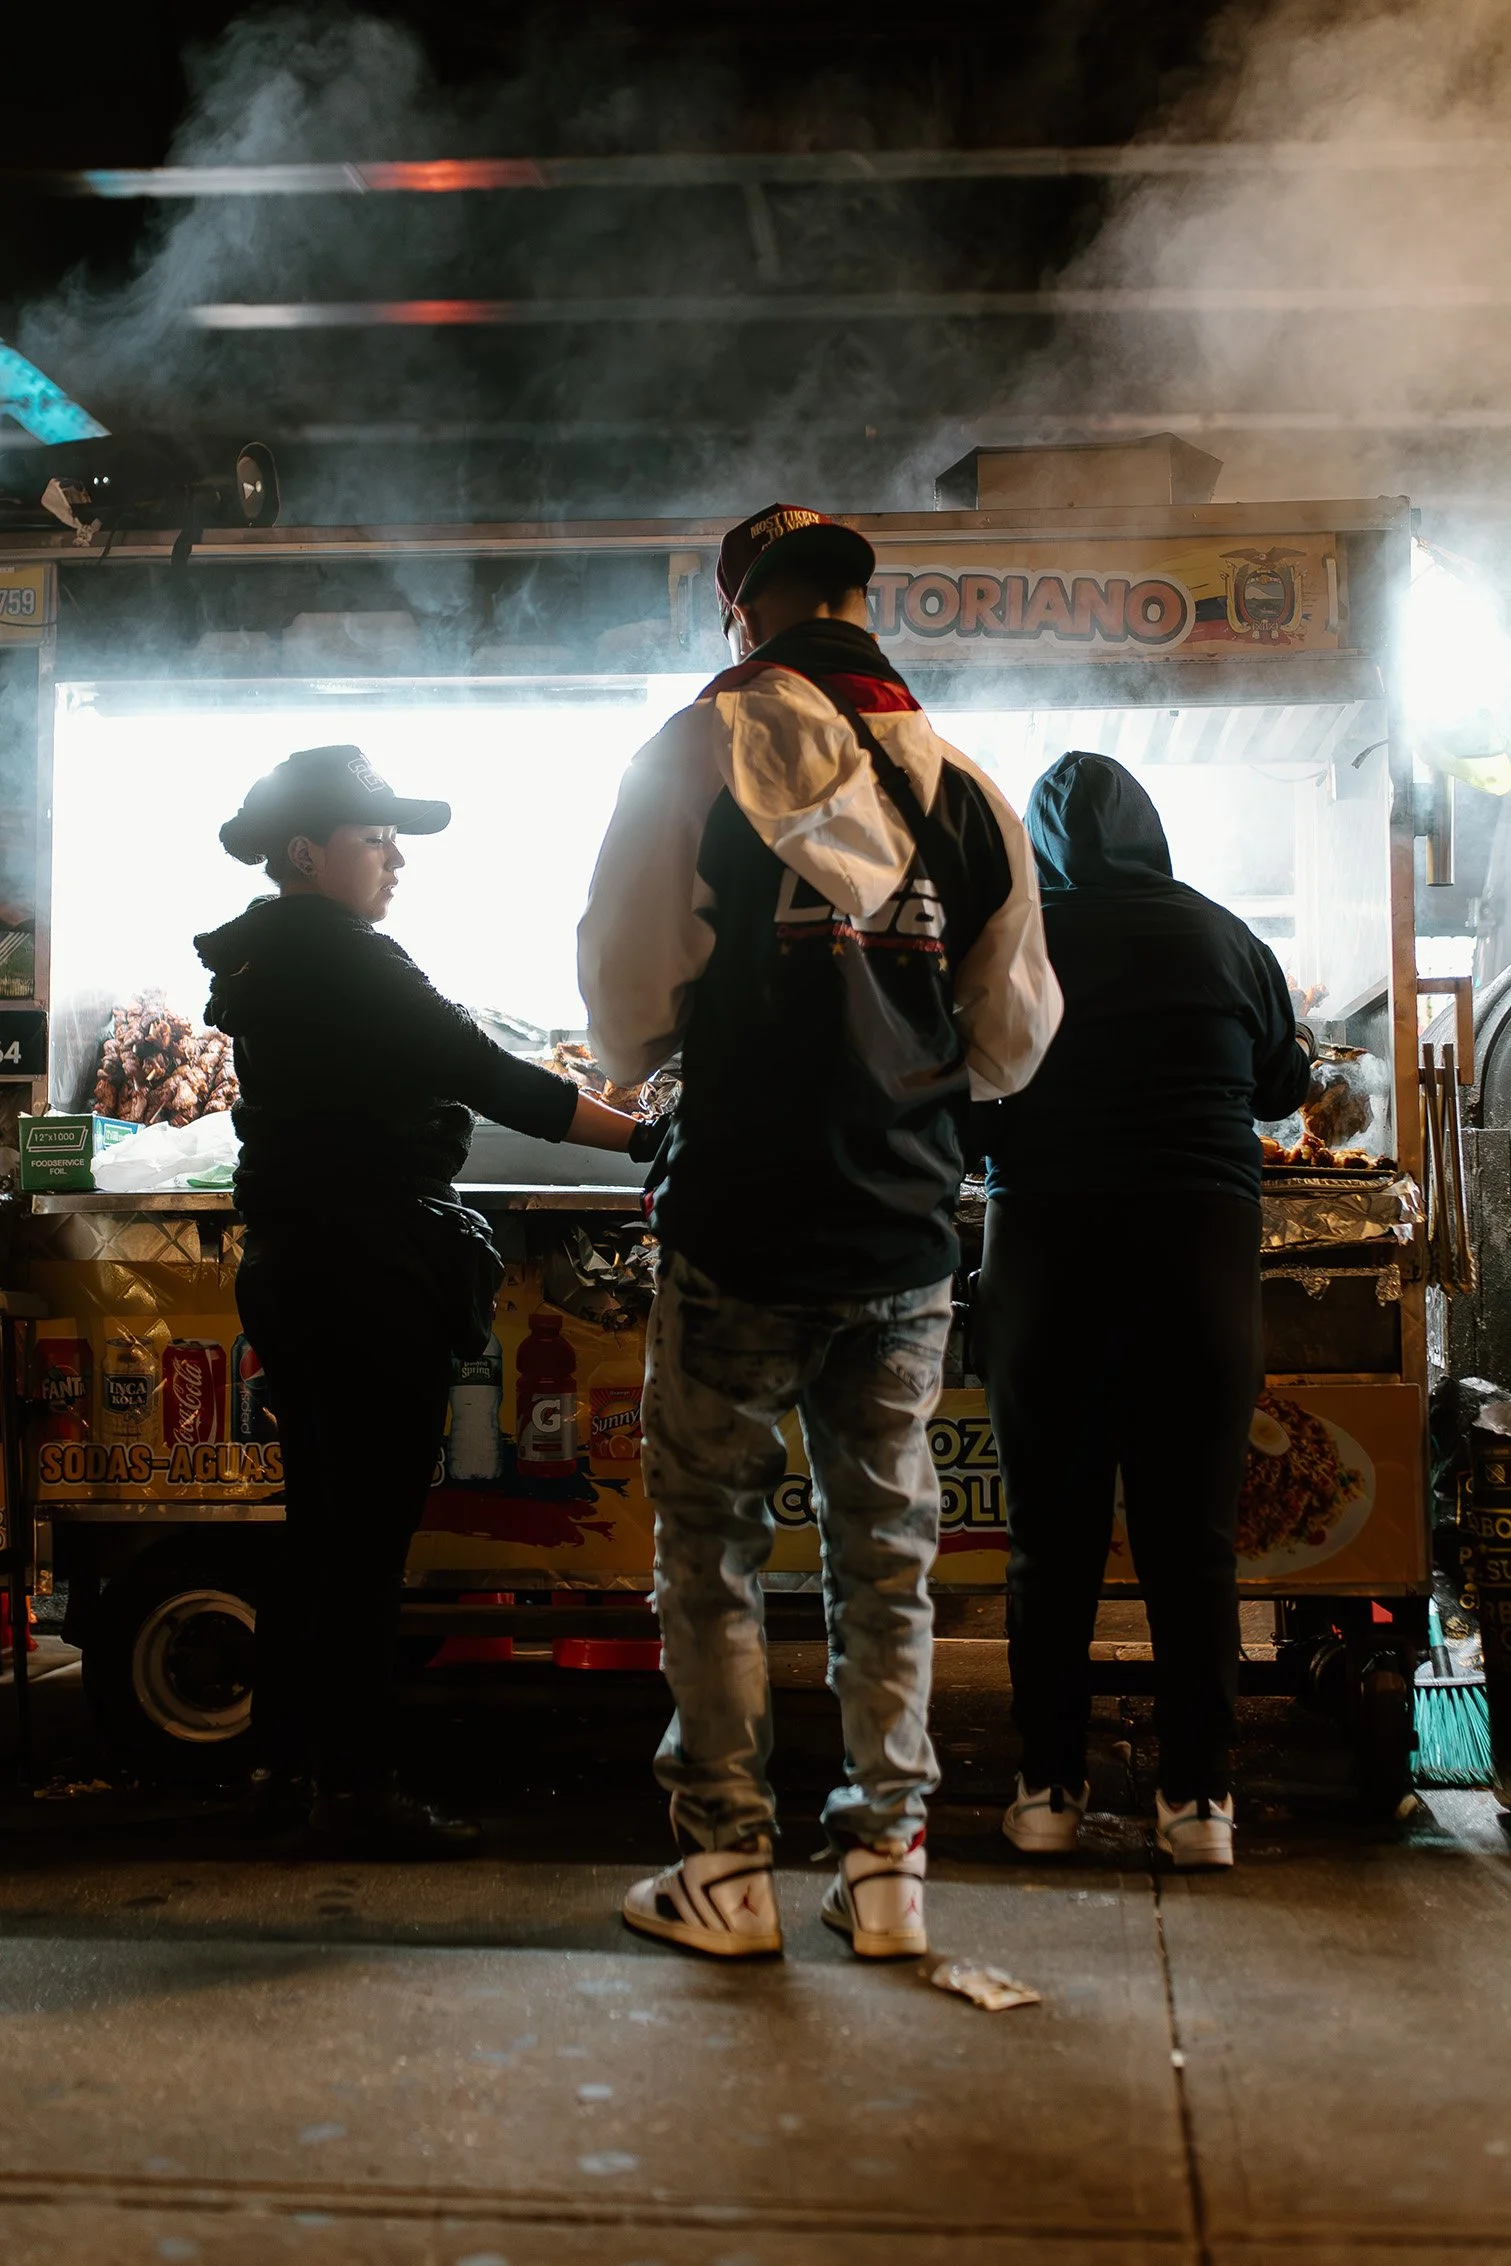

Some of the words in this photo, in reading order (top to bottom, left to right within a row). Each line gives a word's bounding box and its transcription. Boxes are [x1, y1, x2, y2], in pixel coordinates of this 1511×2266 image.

[751, 512, 781, 539] MOST
[0, 588, 37, 616] 759
[866, 572, 1187, 644] TORIANO
[0, 1040, 21, 1064] 4
[31, 1158, 85, 1168] FOODSERVICE
[49, 1167, 67, 1176] FOIL
[461, 1366, 491, 1380] Spring
[109, 1382, 147, 1395] INCA
[531, 1399, 561, 1433] G
[924, 1419, 998, 1468] OZ
[768, 1475, 819, 1526] C
[938, 1475, 1007, 1527] OL
